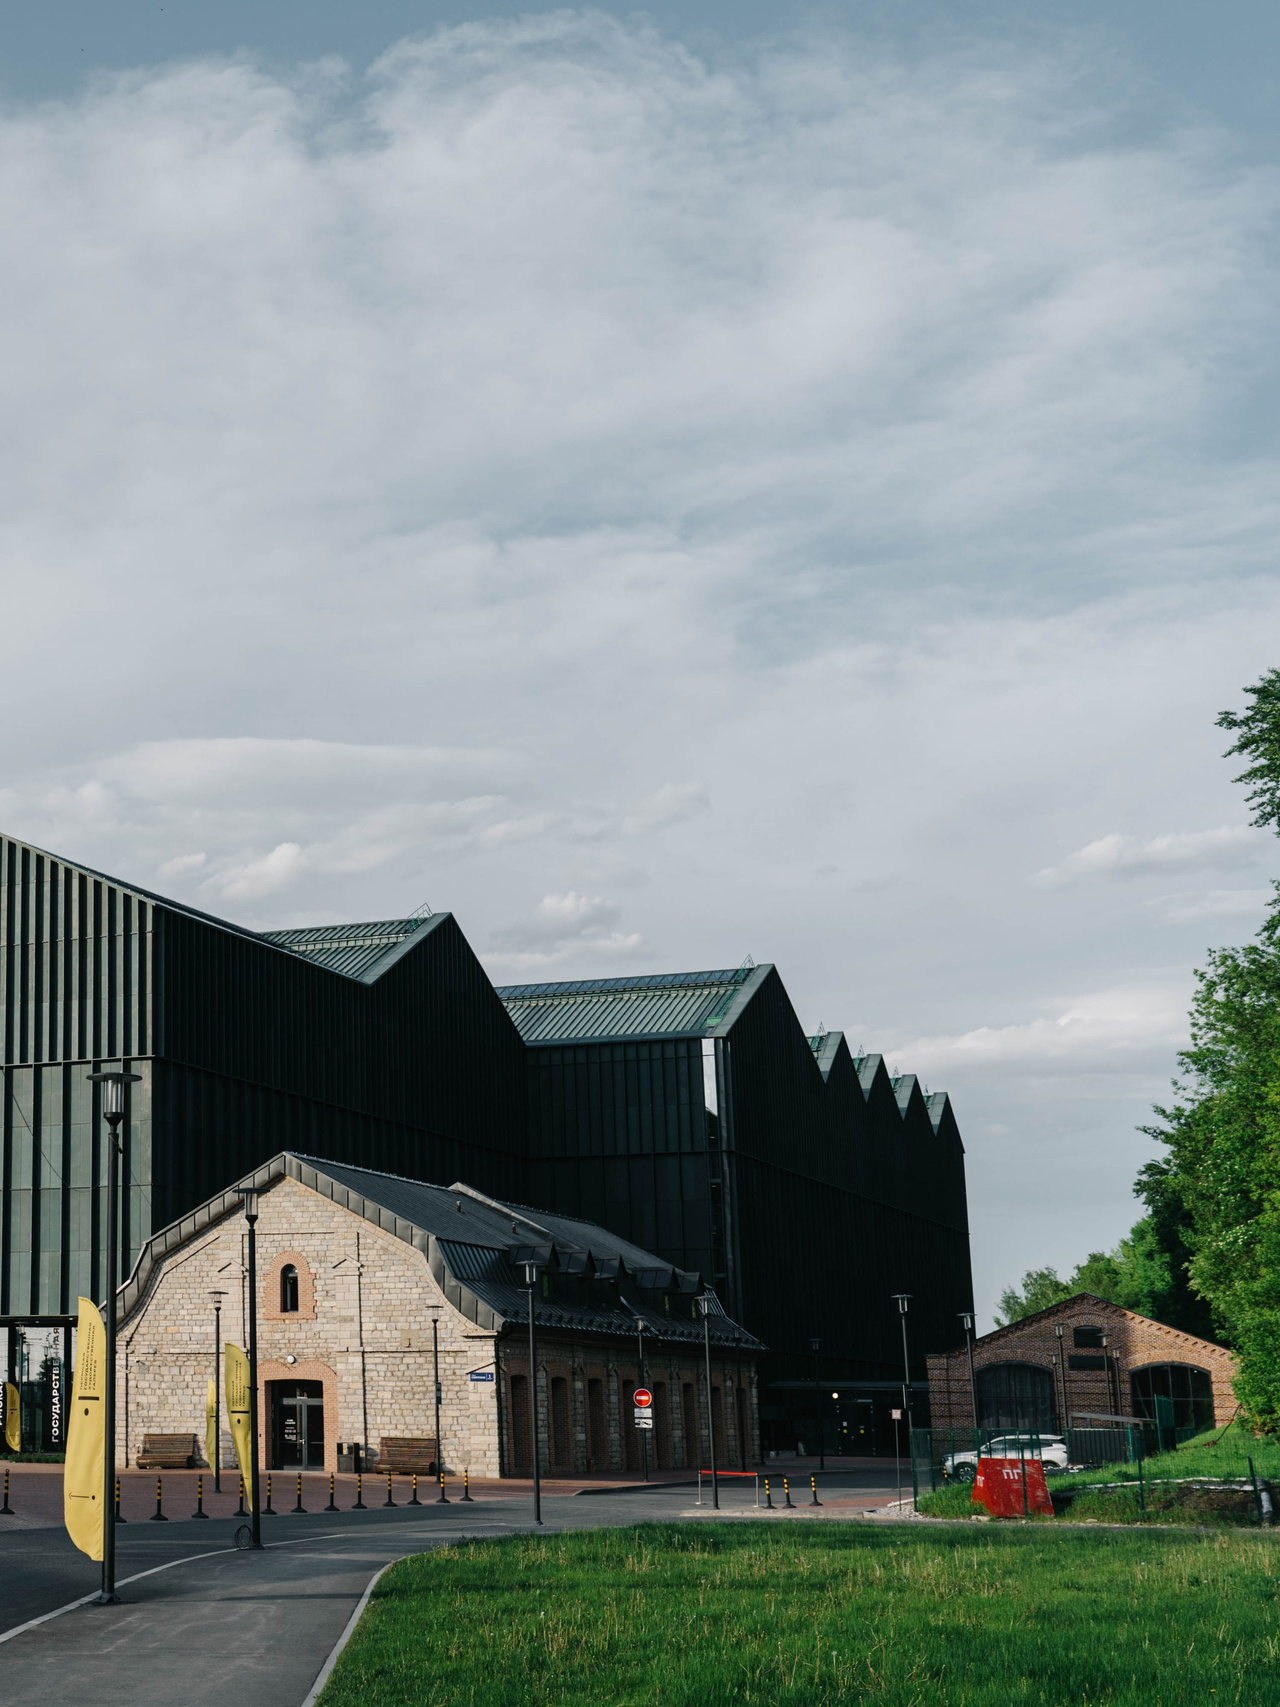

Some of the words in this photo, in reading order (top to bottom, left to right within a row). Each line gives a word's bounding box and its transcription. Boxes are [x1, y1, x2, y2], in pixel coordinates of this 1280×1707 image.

[52, 1327, 60, 1442] ГОСУДАРСТВЕННАЯ
[84, 1322, 92, 1391] ГОСУДАРСТВЕННАЯ
[88, 1325, 96, 1390] ХУДОЖЕСТВЕННАЯ
